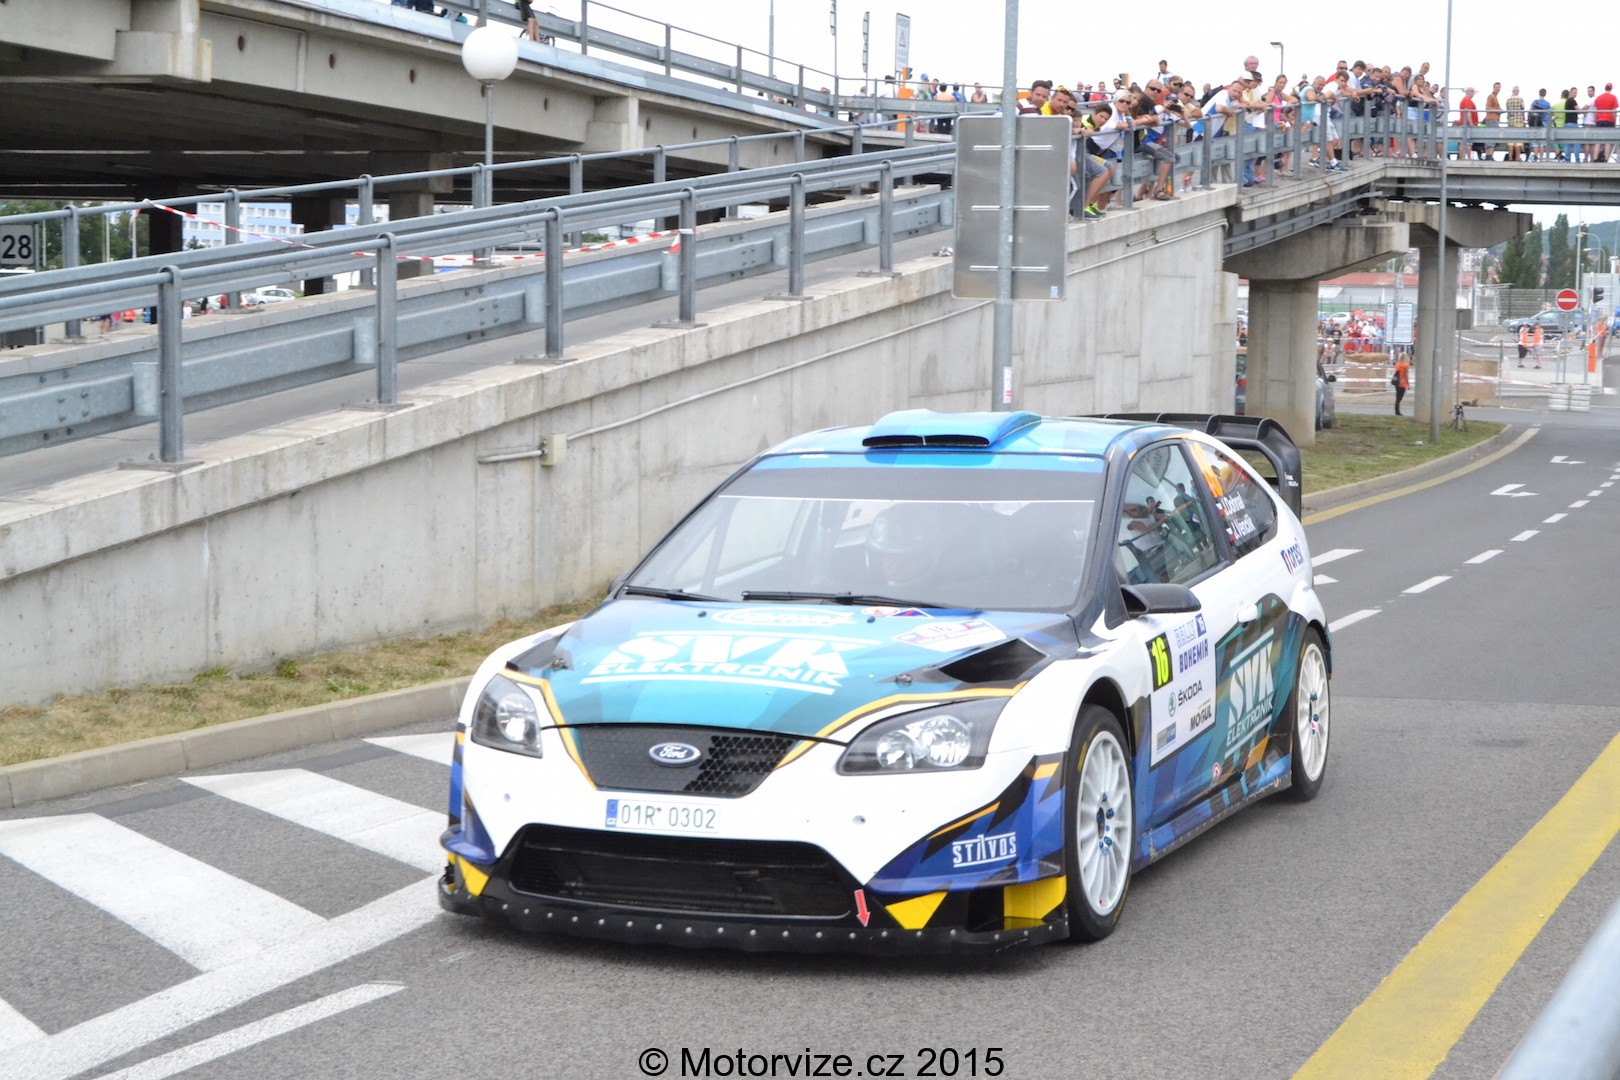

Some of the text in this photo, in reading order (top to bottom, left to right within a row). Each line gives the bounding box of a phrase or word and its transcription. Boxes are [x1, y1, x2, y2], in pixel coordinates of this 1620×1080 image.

[2, 234, 31, 259] 28
[600, 635, 868, 674] SVK
[1152, 636, 1169, 686] 16
[1179, 638, 1208, 673] BOHEMIA
[588, 661, 843, 687] ELEKTRONIK
[1228, 640, 1274, 728] SVK
[1178, 680, 1203, 707] ŠKODA
[1190, 704, 1212, 732] MOGUL
[1226, 694, 1274, 747] ELEKTRONIK
[659, 745, 688, 759] Ford
[668, 806, 716, 829] 0302
